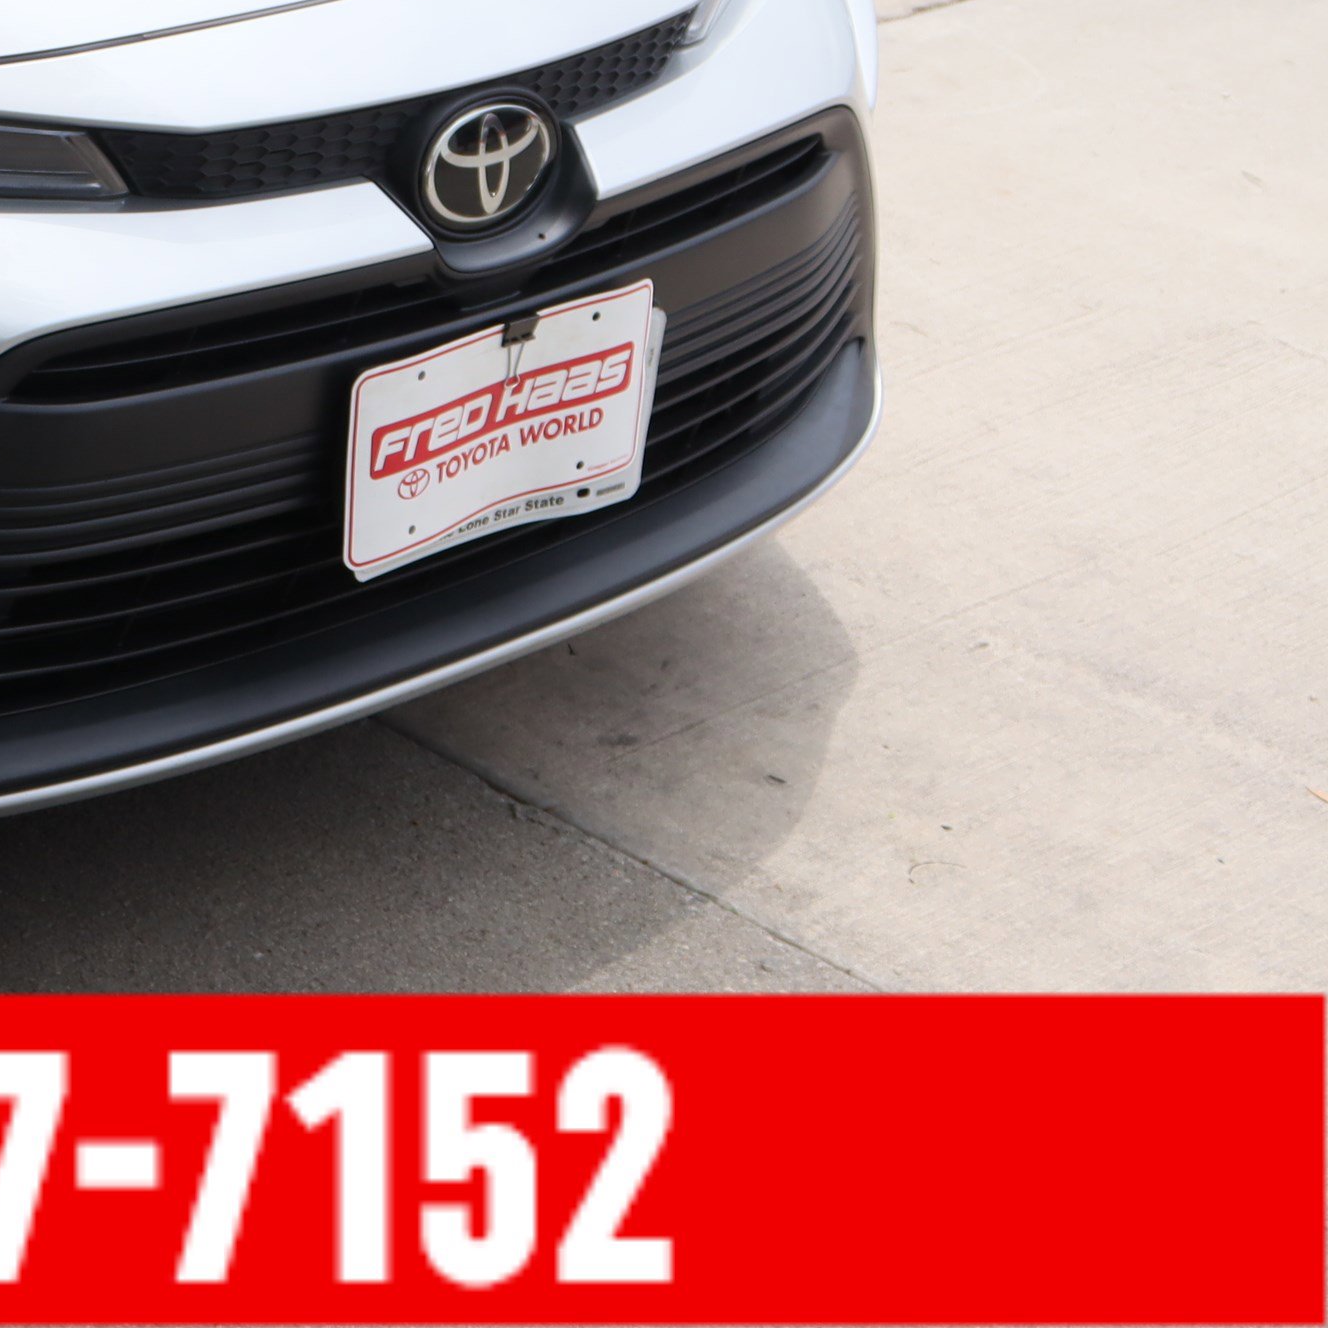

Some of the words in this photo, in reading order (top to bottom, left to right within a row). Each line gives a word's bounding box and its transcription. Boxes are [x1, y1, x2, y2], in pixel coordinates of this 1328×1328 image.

[436, 432, 511, 484] TOYOTA
[519, 407, 605, 447] WORLD
[494, 504, 521, 522] Star
[524, 495, 565, 512] State
